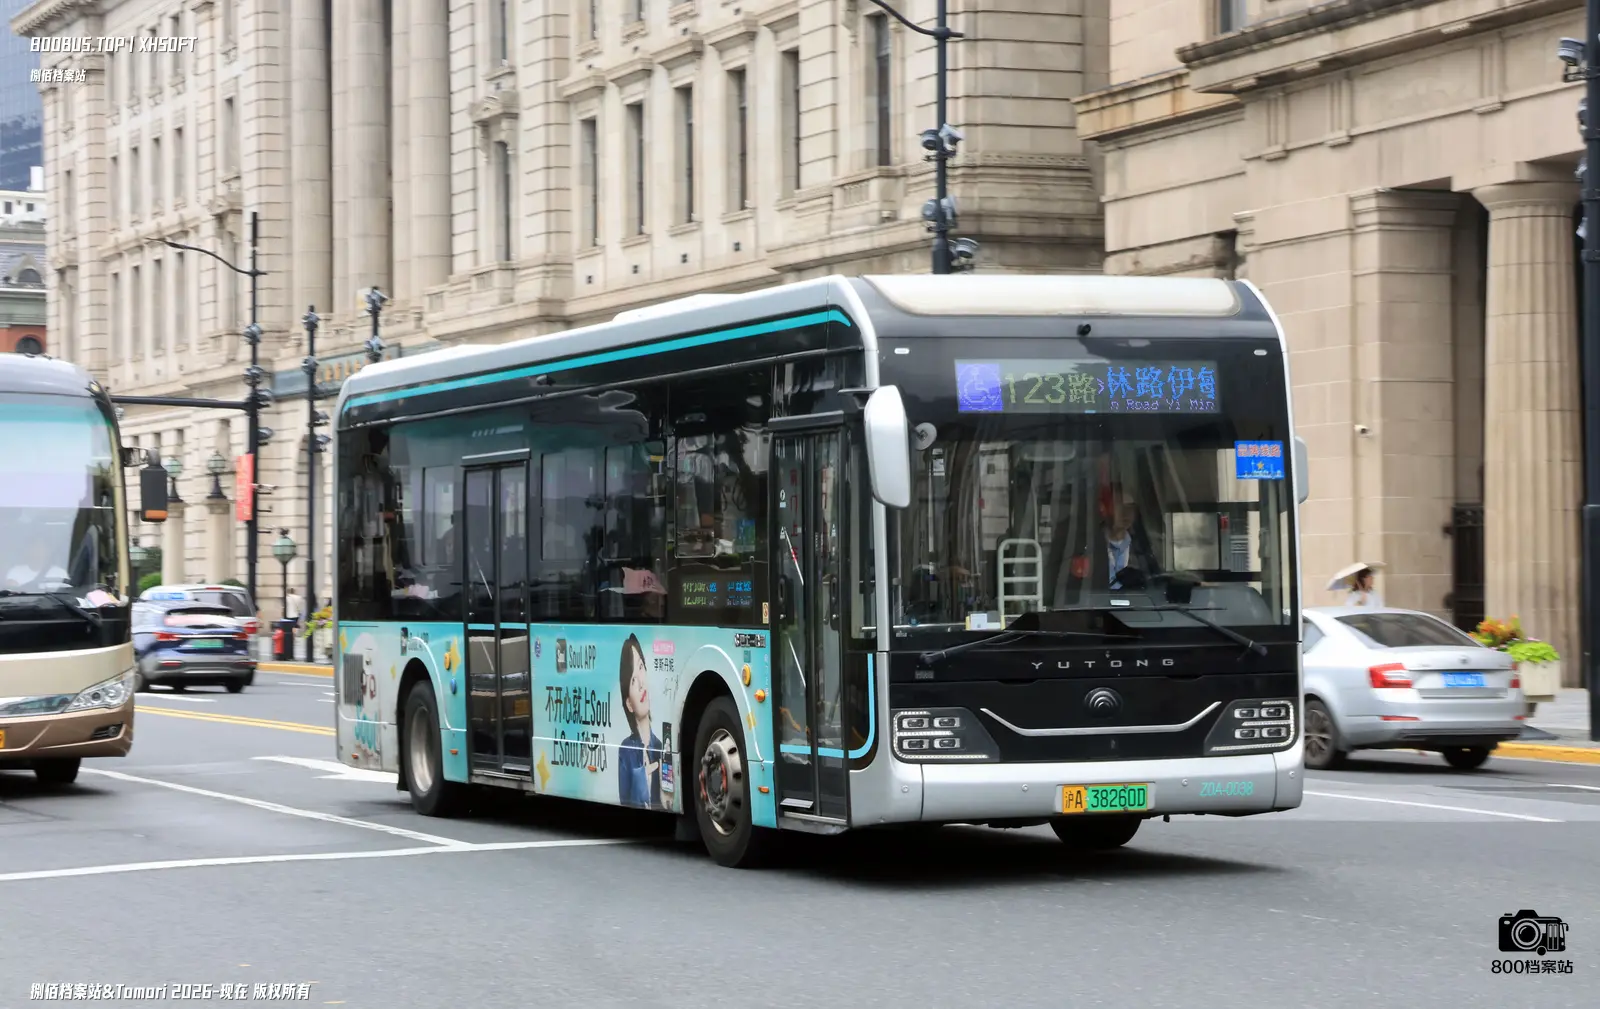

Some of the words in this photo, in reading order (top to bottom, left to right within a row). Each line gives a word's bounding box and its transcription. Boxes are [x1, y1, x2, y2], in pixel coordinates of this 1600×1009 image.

[1005, 373, 1096, 403] 123路
[1126, 399, 1159, 410] Road
[1166, 399, 1180, 410] Yi
[569, 644, 583, 668] Soul
[585, 644, 596, 669] APP
[1031, 658, 1175, 671] YUTONG
[545, 686, 612, 728] 不开心就上Soul
[551, 728, 607, 772] 上Soul秒开心
